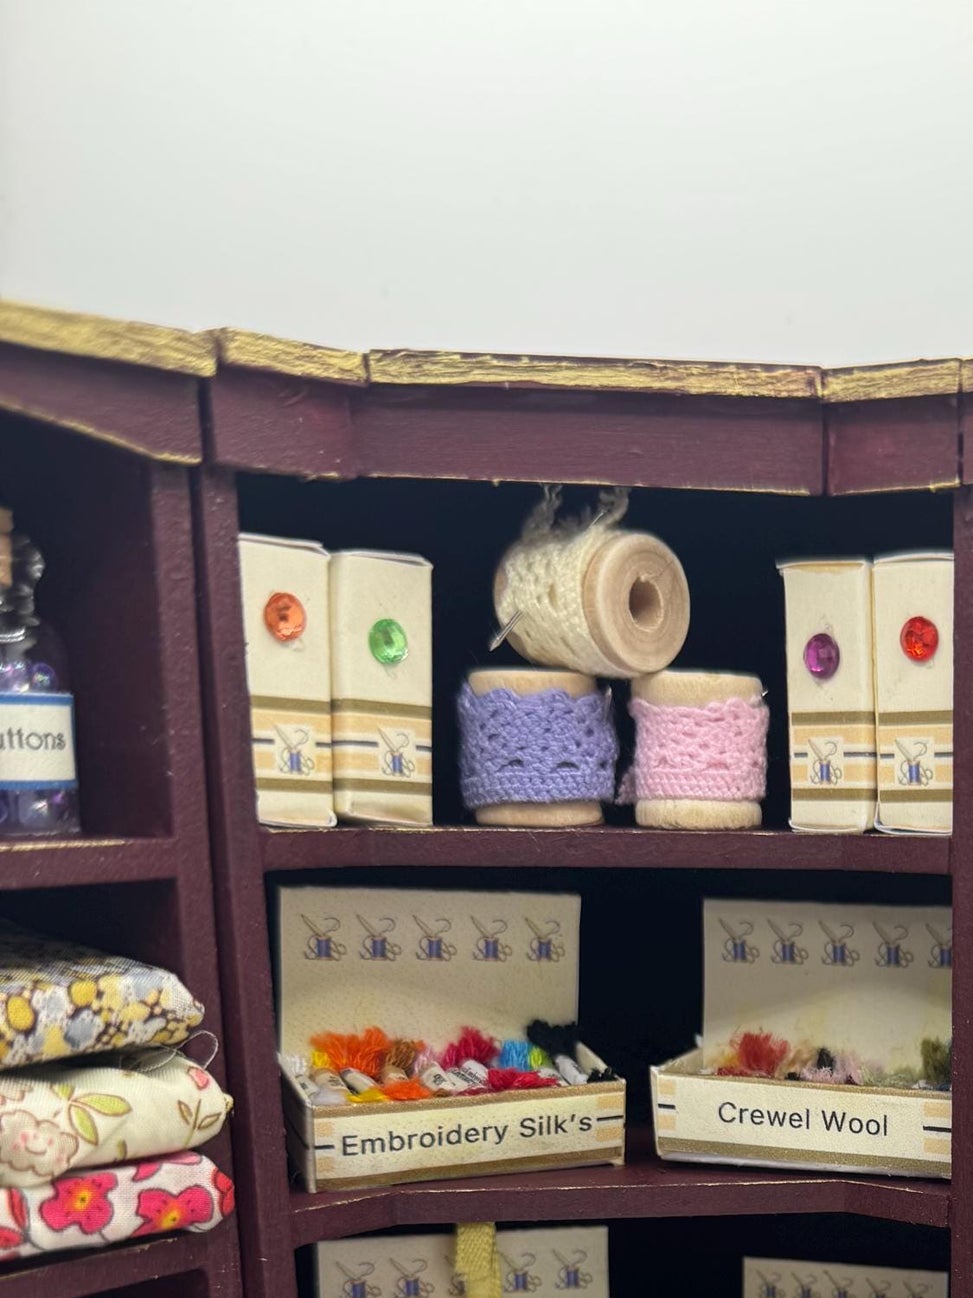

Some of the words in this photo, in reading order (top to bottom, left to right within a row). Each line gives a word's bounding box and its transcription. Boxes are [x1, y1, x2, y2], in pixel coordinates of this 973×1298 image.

[341, 1121, 508, 1157] Embroidery
[519, 1112, 593, 1139] Silk's
[718, 1101, 810, 1130] Crewel
[821, 1109, 888, 1137] Wool
